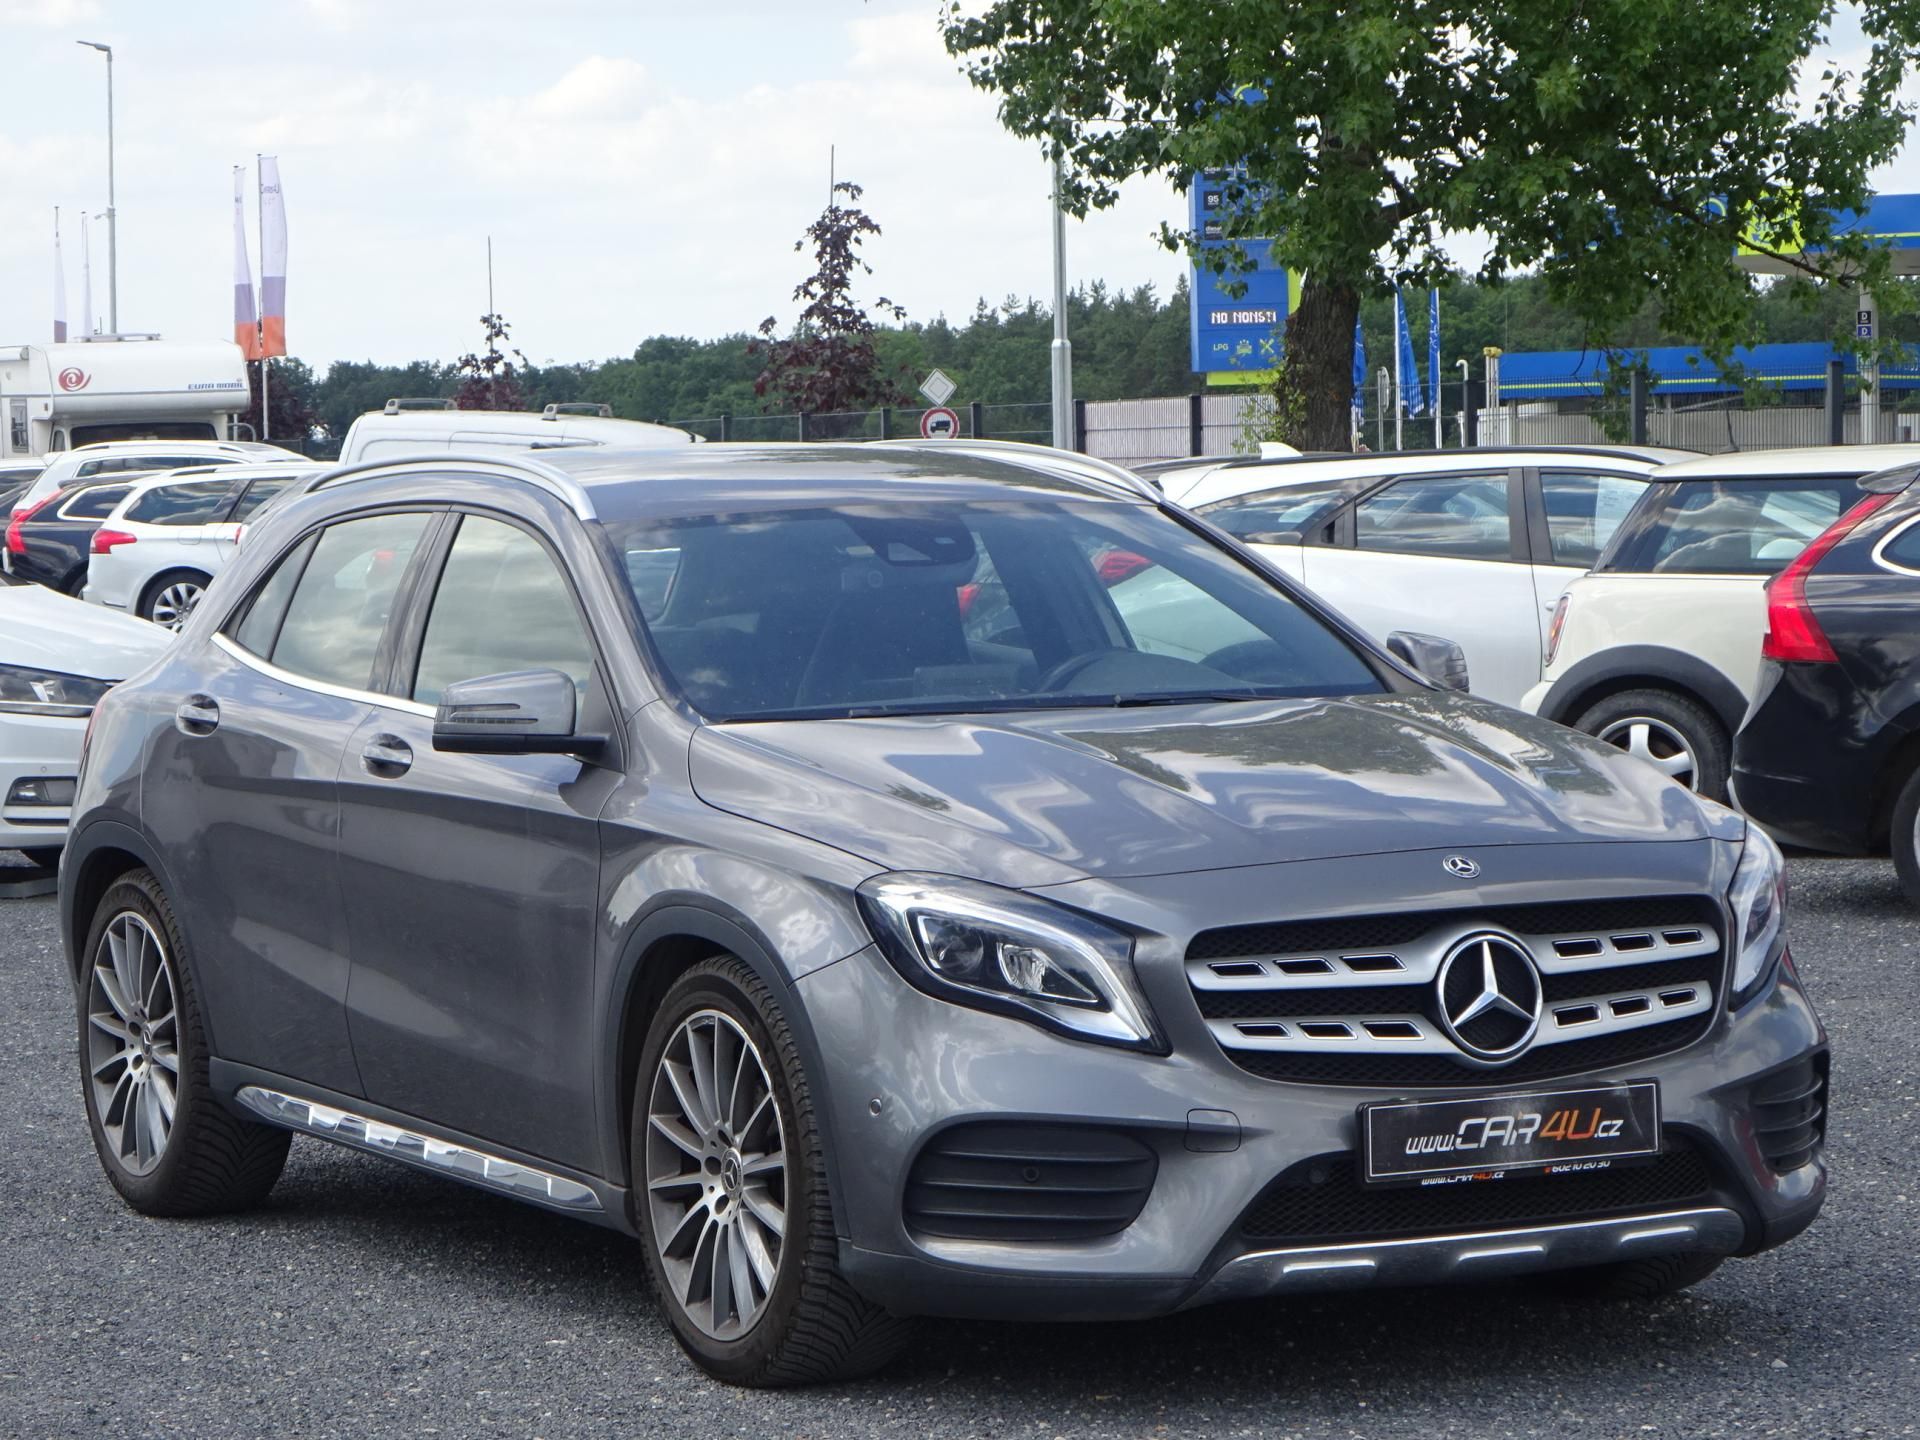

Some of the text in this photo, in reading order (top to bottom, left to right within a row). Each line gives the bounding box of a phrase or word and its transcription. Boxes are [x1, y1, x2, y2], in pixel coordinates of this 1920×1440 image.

[1207, 195, 1219, 203] 95
[1211, 312, 1228, 324] NO
[1861, 312, 1868, 320] D
[1861, 327, 1868, 335] D
[1213, 343, 1229, 351] LPG
[1405, 1107, 1624, 1154] www.CAR4U.cz
